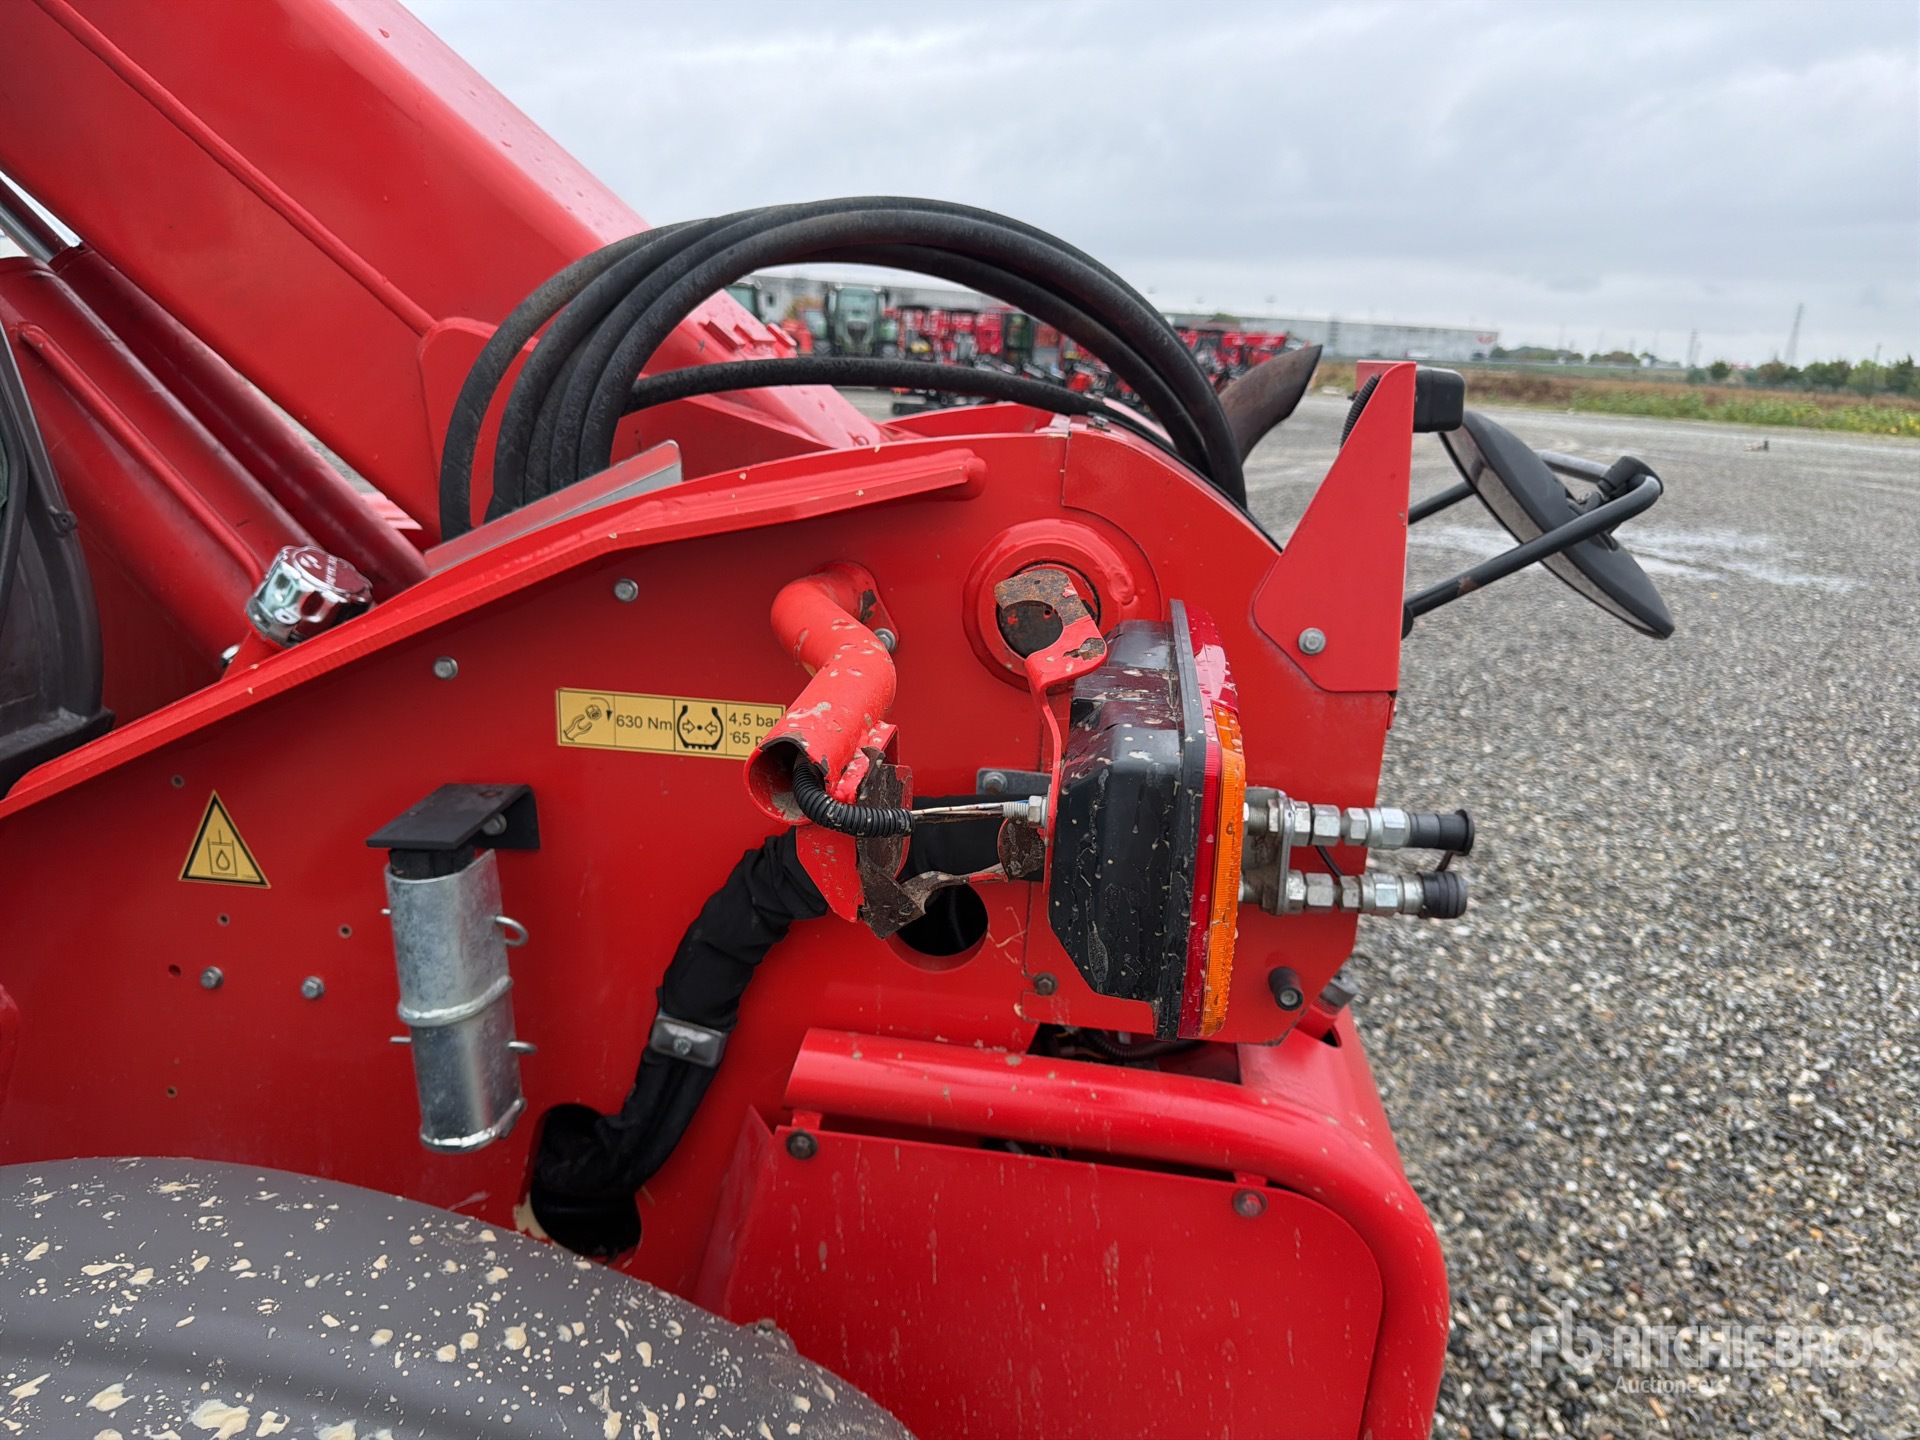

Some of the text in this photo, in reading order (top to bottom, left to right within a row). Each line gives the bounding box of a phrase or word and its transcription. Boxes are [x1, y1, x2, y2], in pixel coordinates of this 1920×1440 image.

[616, 714, 673, 731] 630 Nm
[729, 712, 751, 727] 4,5
